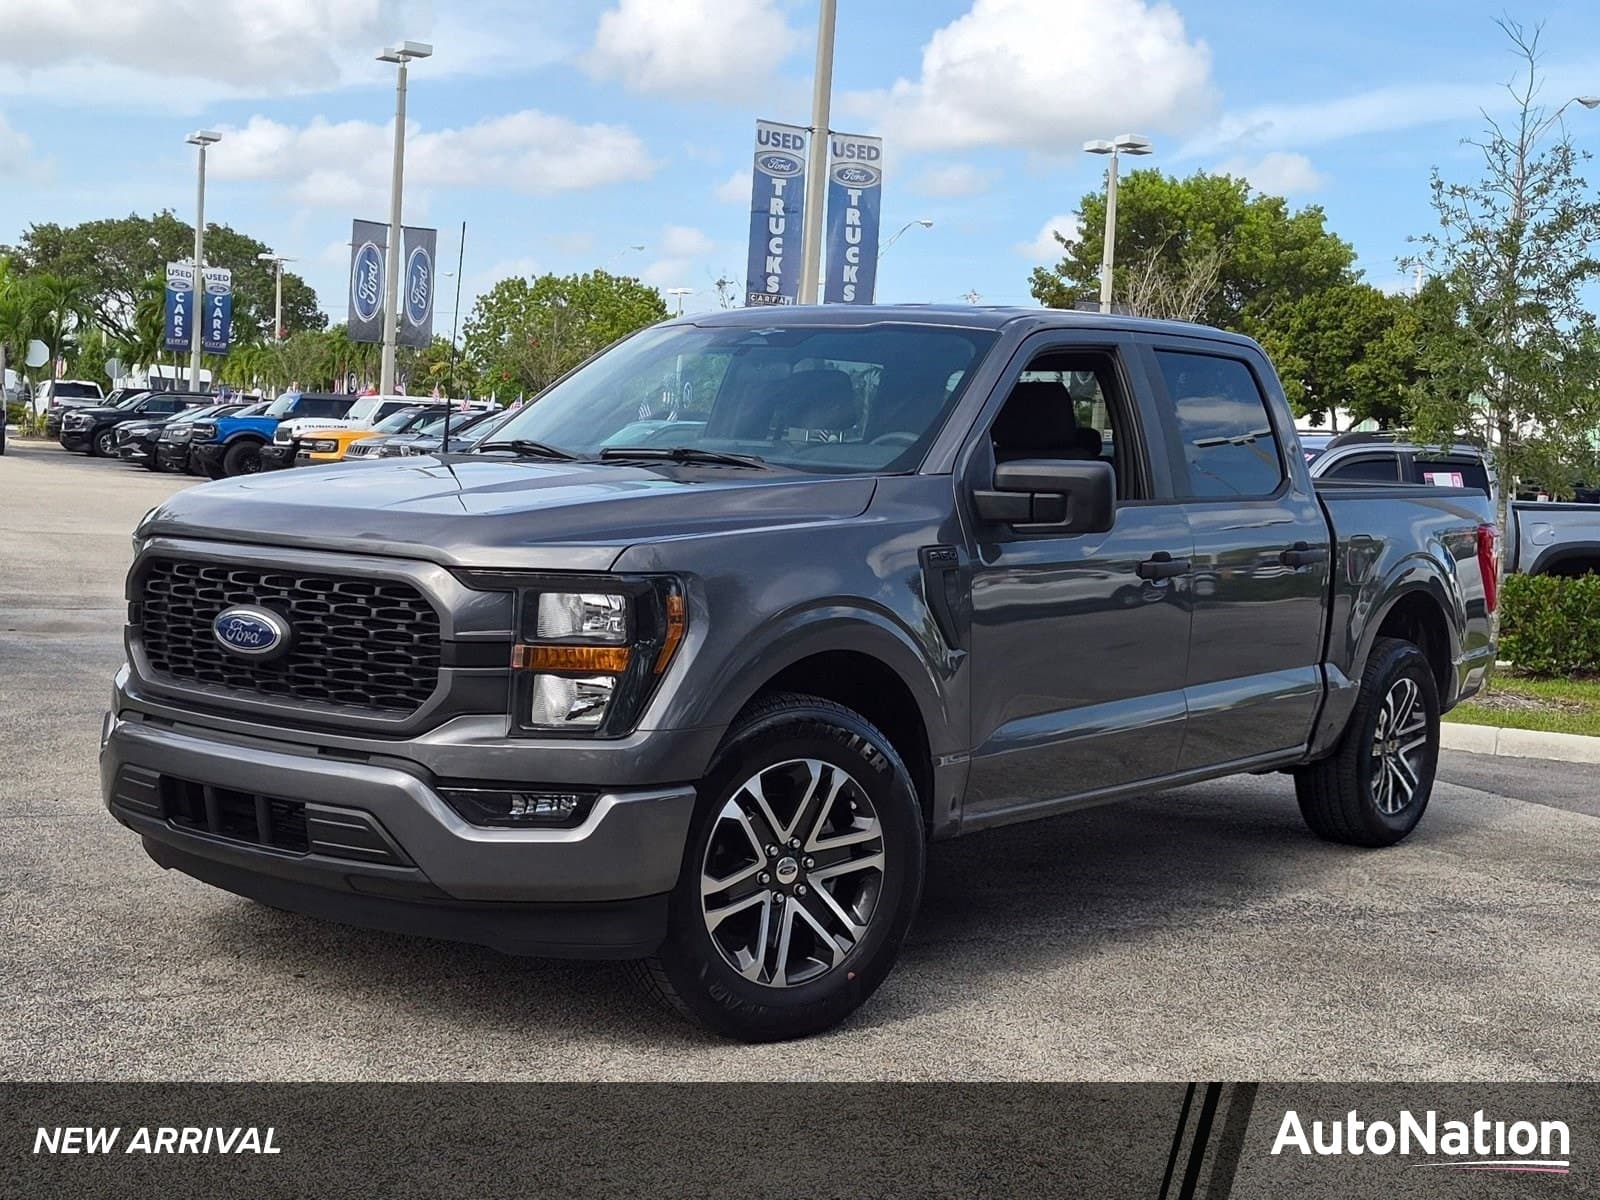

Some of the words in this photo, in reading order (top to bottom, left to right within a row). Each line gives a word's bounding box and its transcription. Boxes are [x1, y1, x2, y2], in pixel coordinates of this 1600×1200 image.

[757, 128, 804, 151] USED
[832, 141, 880, 161] USED
[767, 158, 791, 171] Ford
[843, 169, 866, 182] Ford
[766, 178, 787, 294] TRUCKS
[843, 188, 862, 302] TRUCKS
[168, 268, 192, 279] USED
[205, 273, 229, 282] USED
[358, 259, 379, 305] Ford
[410, 264, 428, 309] Ford
[174, 292, 184, 337] CARS
[212, 296, 223, 340] CARS
[226, 619, 262, 643] Ford
